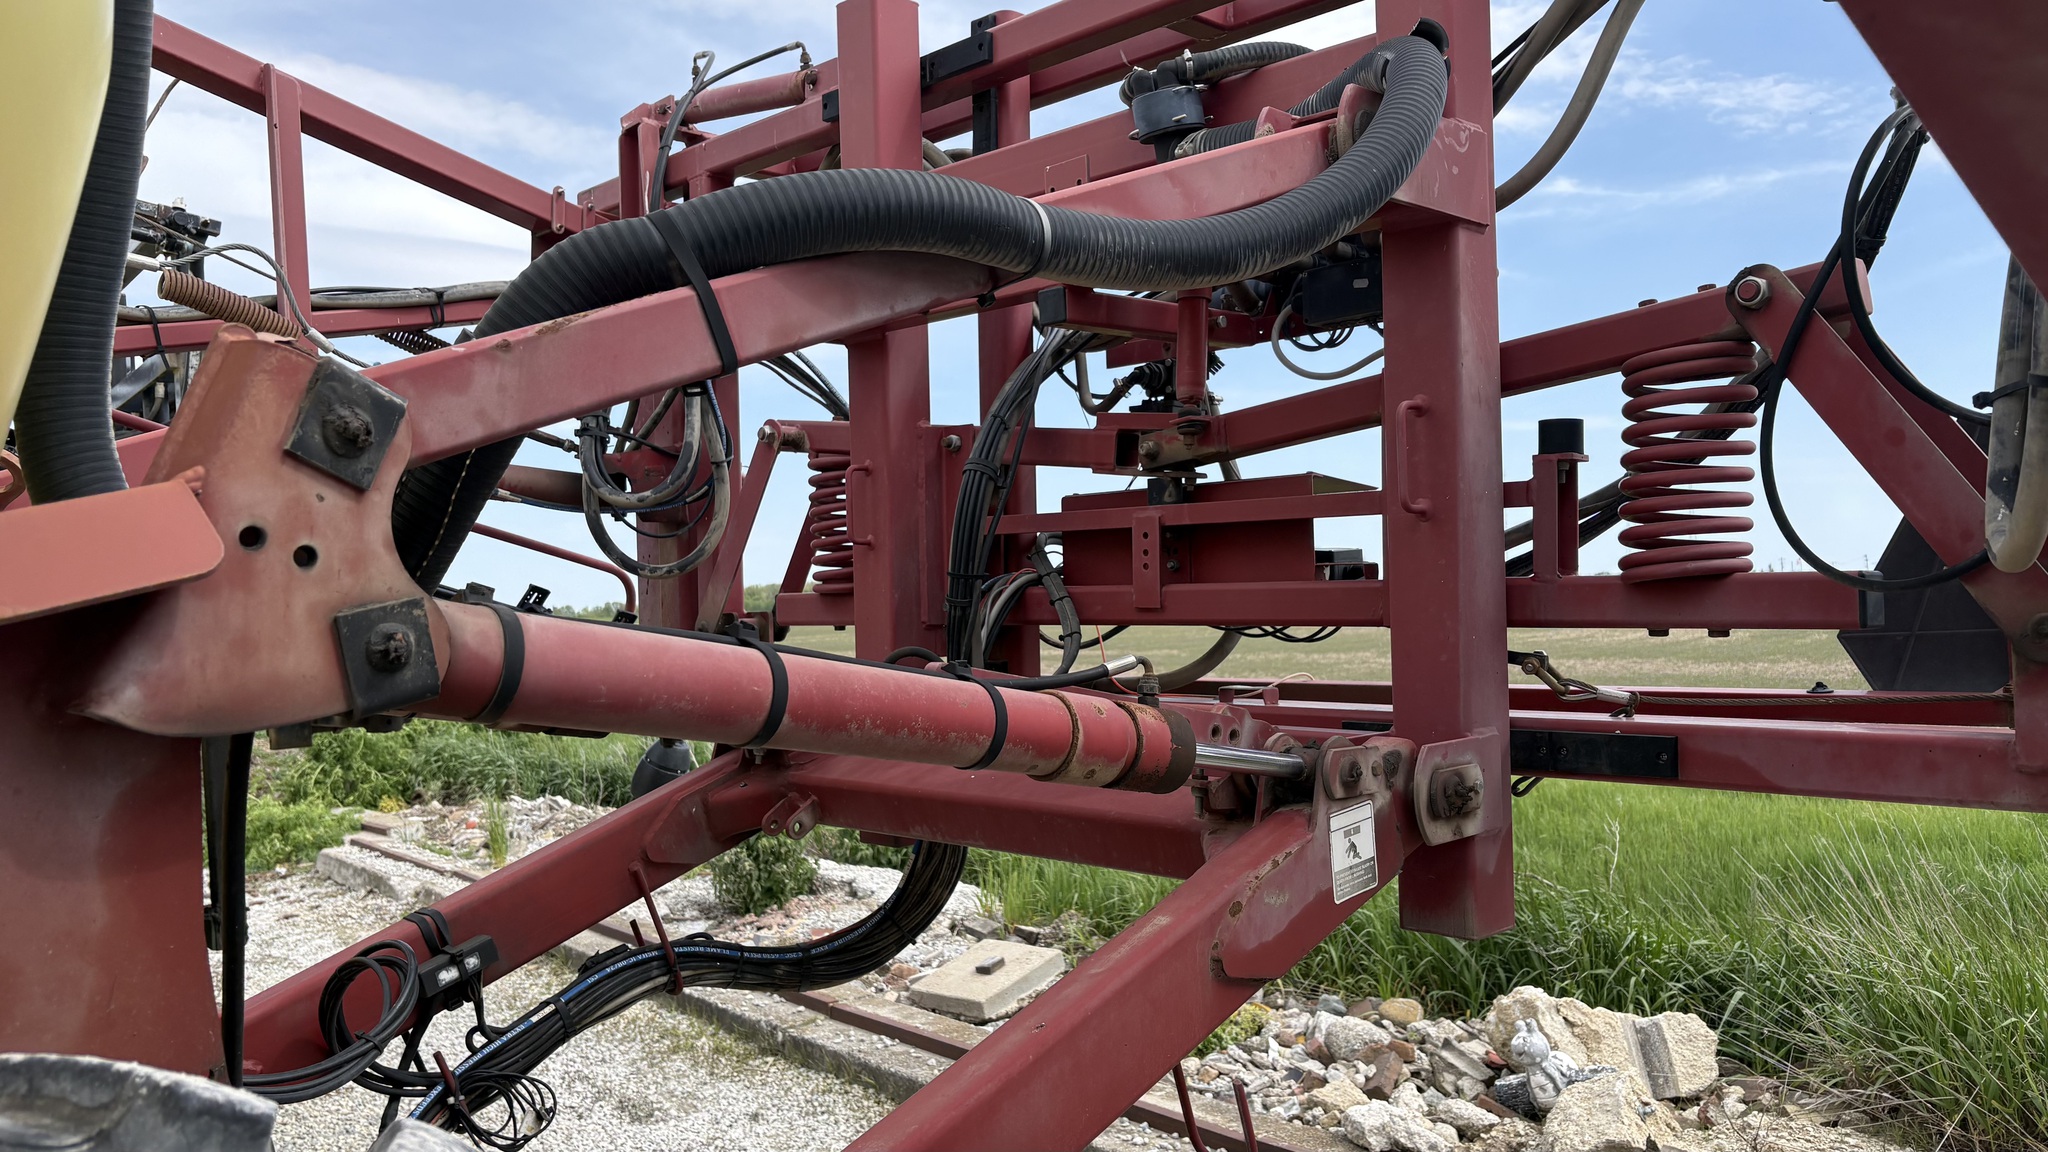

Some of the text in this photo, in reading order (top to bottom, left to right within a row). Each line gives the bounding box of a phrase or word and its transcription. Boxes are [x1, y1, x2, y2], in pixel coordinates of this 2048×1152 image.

[706, 946, 730, 954] FLAME
[412, 1023, 525, 1116] EXTRA HIGH PRESSU EXCEEDS
